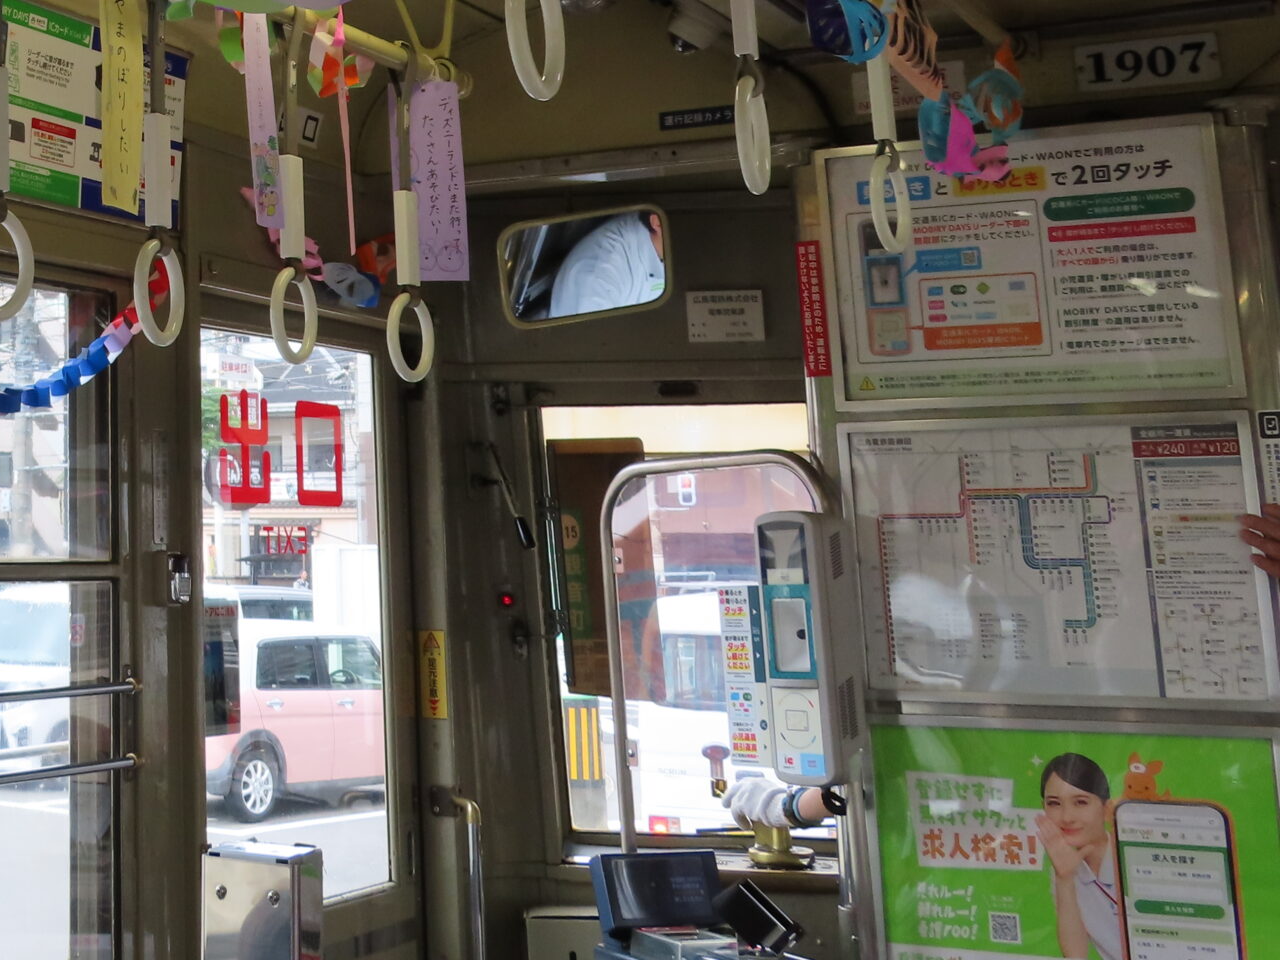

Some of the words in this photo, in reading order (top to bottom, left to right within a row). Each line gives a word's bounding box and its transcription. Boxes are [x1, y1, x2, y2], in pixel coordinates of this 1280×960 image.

[1085, 41, 1207, 84] 1907
[1011, 144, 1145, 163] ード・WAONでご利用の方は
[935, 181, 948, 196] と
[219, 388, 344, 508] 出口
[565, 525, 578, 539] 15
[724, 606, 744, 616] タッチ
[727, 642, 746, 651] タッチ
[921, 827, 1038, 865] 求人検索!
